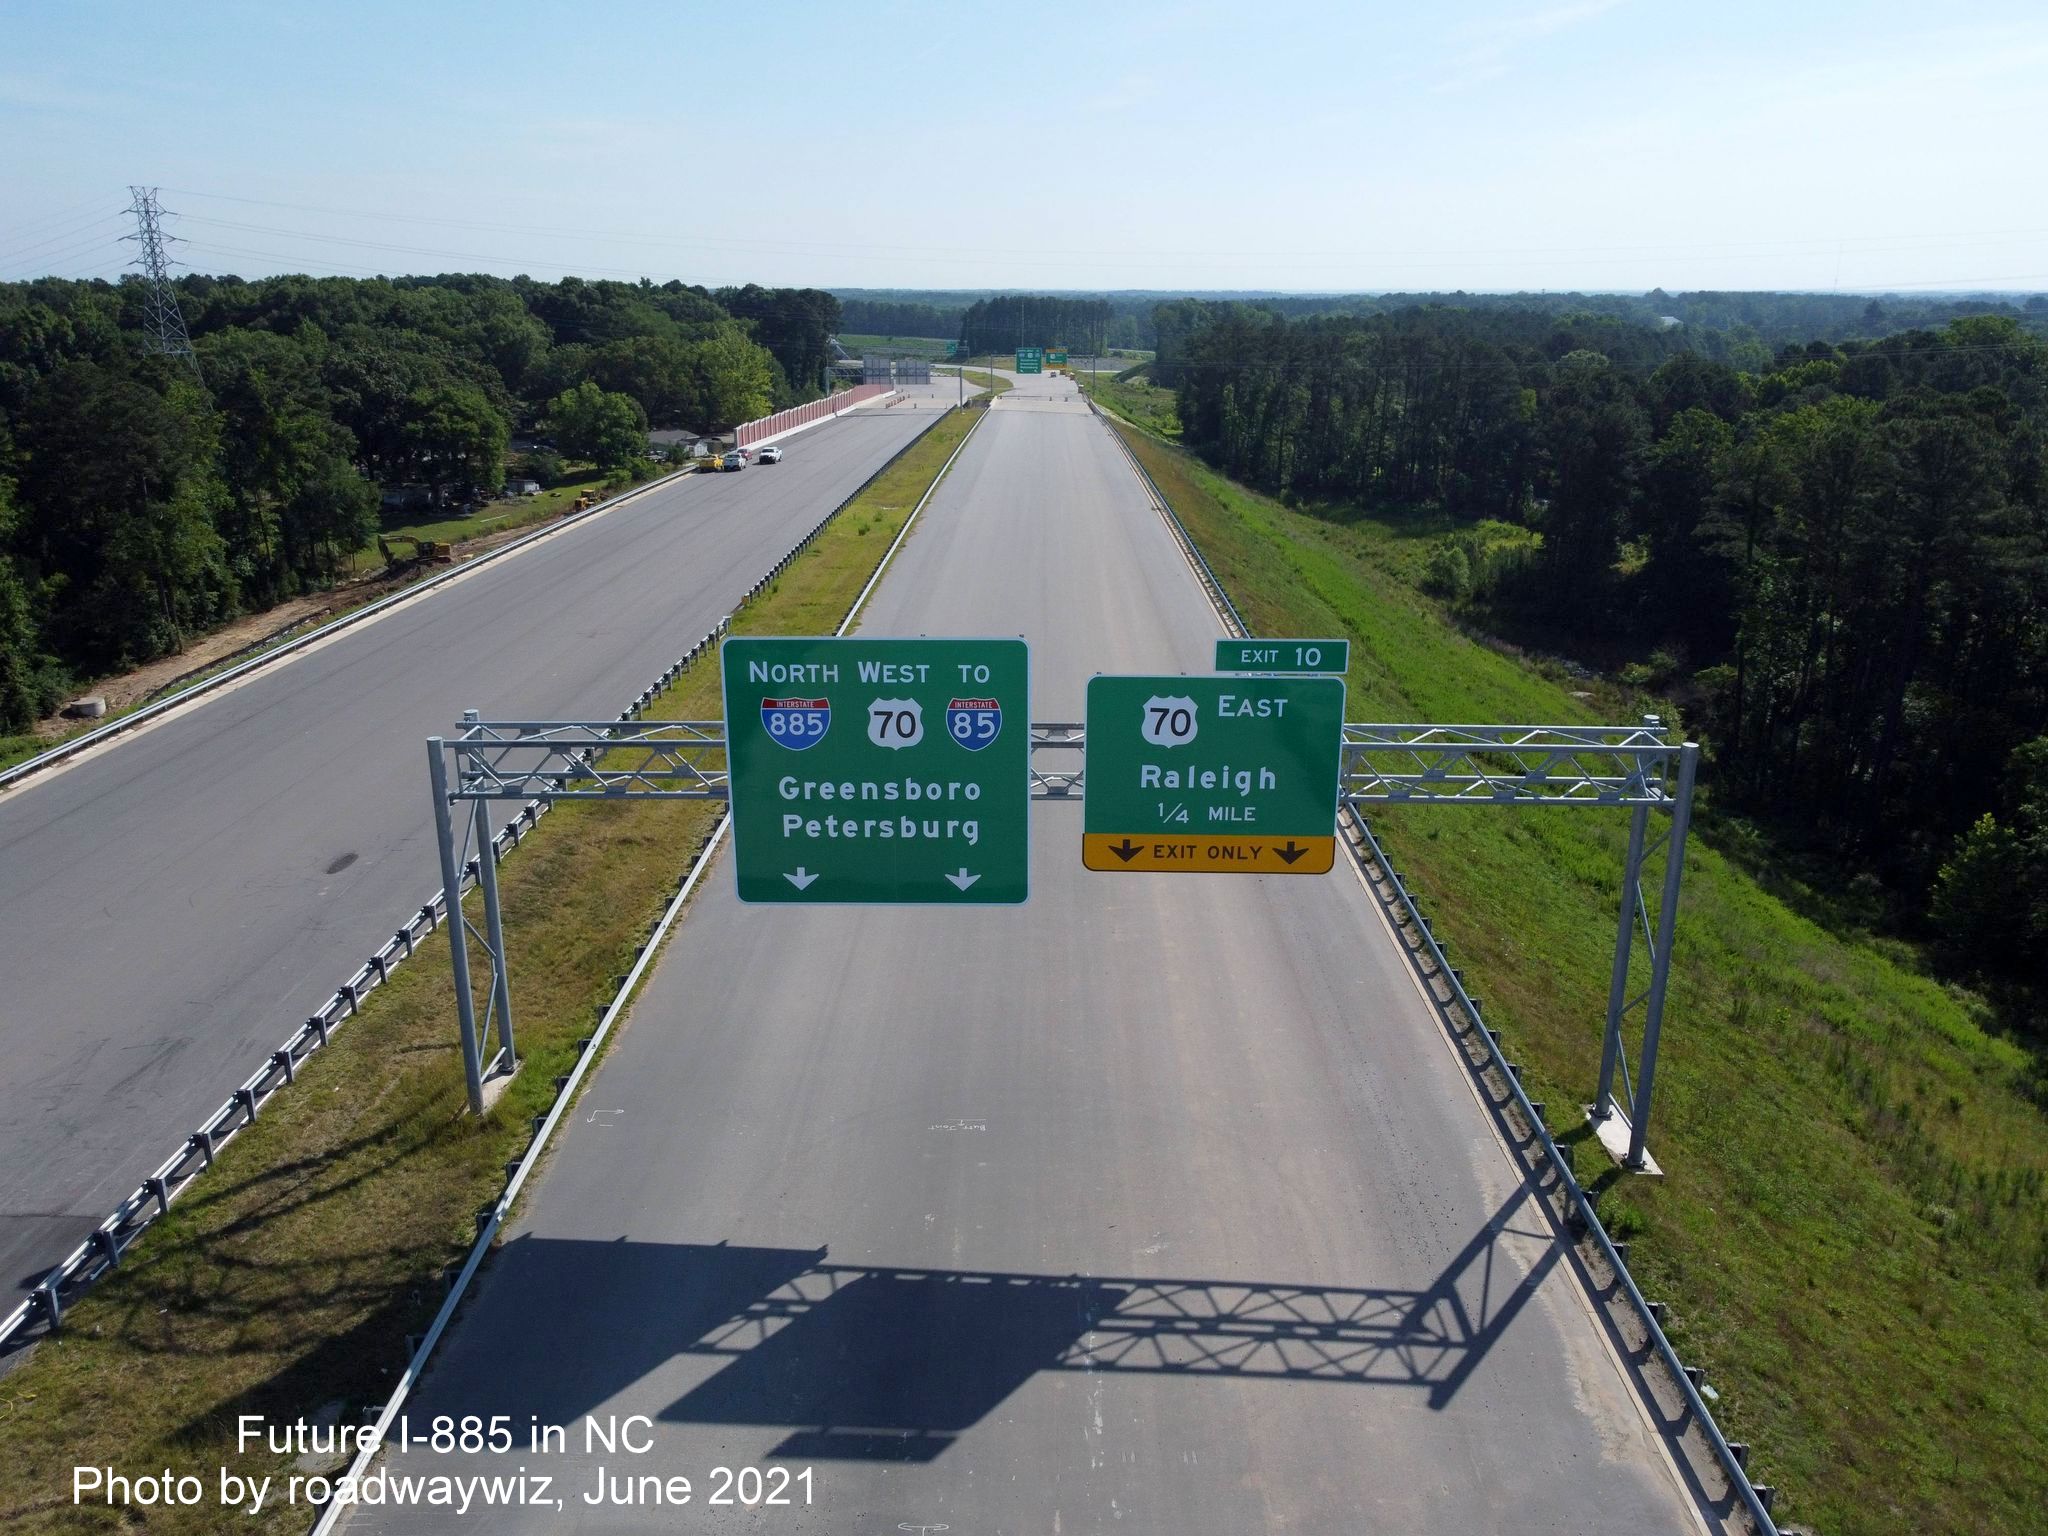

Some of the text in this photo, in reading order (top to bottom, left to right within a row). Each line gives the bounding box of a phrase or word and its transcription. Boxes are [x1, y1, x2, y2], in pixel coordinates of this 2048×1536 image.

[1242, 648, 1321, 666] EXIT 10
[750, 661, 989, 683] NORTH WEST TO
[776, 701, 815, 709] INTERSTATE
[954, 701, 993, 709] INTERSTATE
[1219, 695, 1288, 717] EAST
[770, 712, 824, 736] 885
[874, 711, 916, 738] 70
[953, 712, 995, 739] 85
[1149, 708, 1192, 737] 70
[779, 776, 980, 800] Greensboro
[1141, 765, 1275, 796] Raleigh
[1209, 807, 1255, 821] MILE
[784, 815, 978, 845] Petersburg
[1154, 845, 1262, 859] EXIT ONLY
